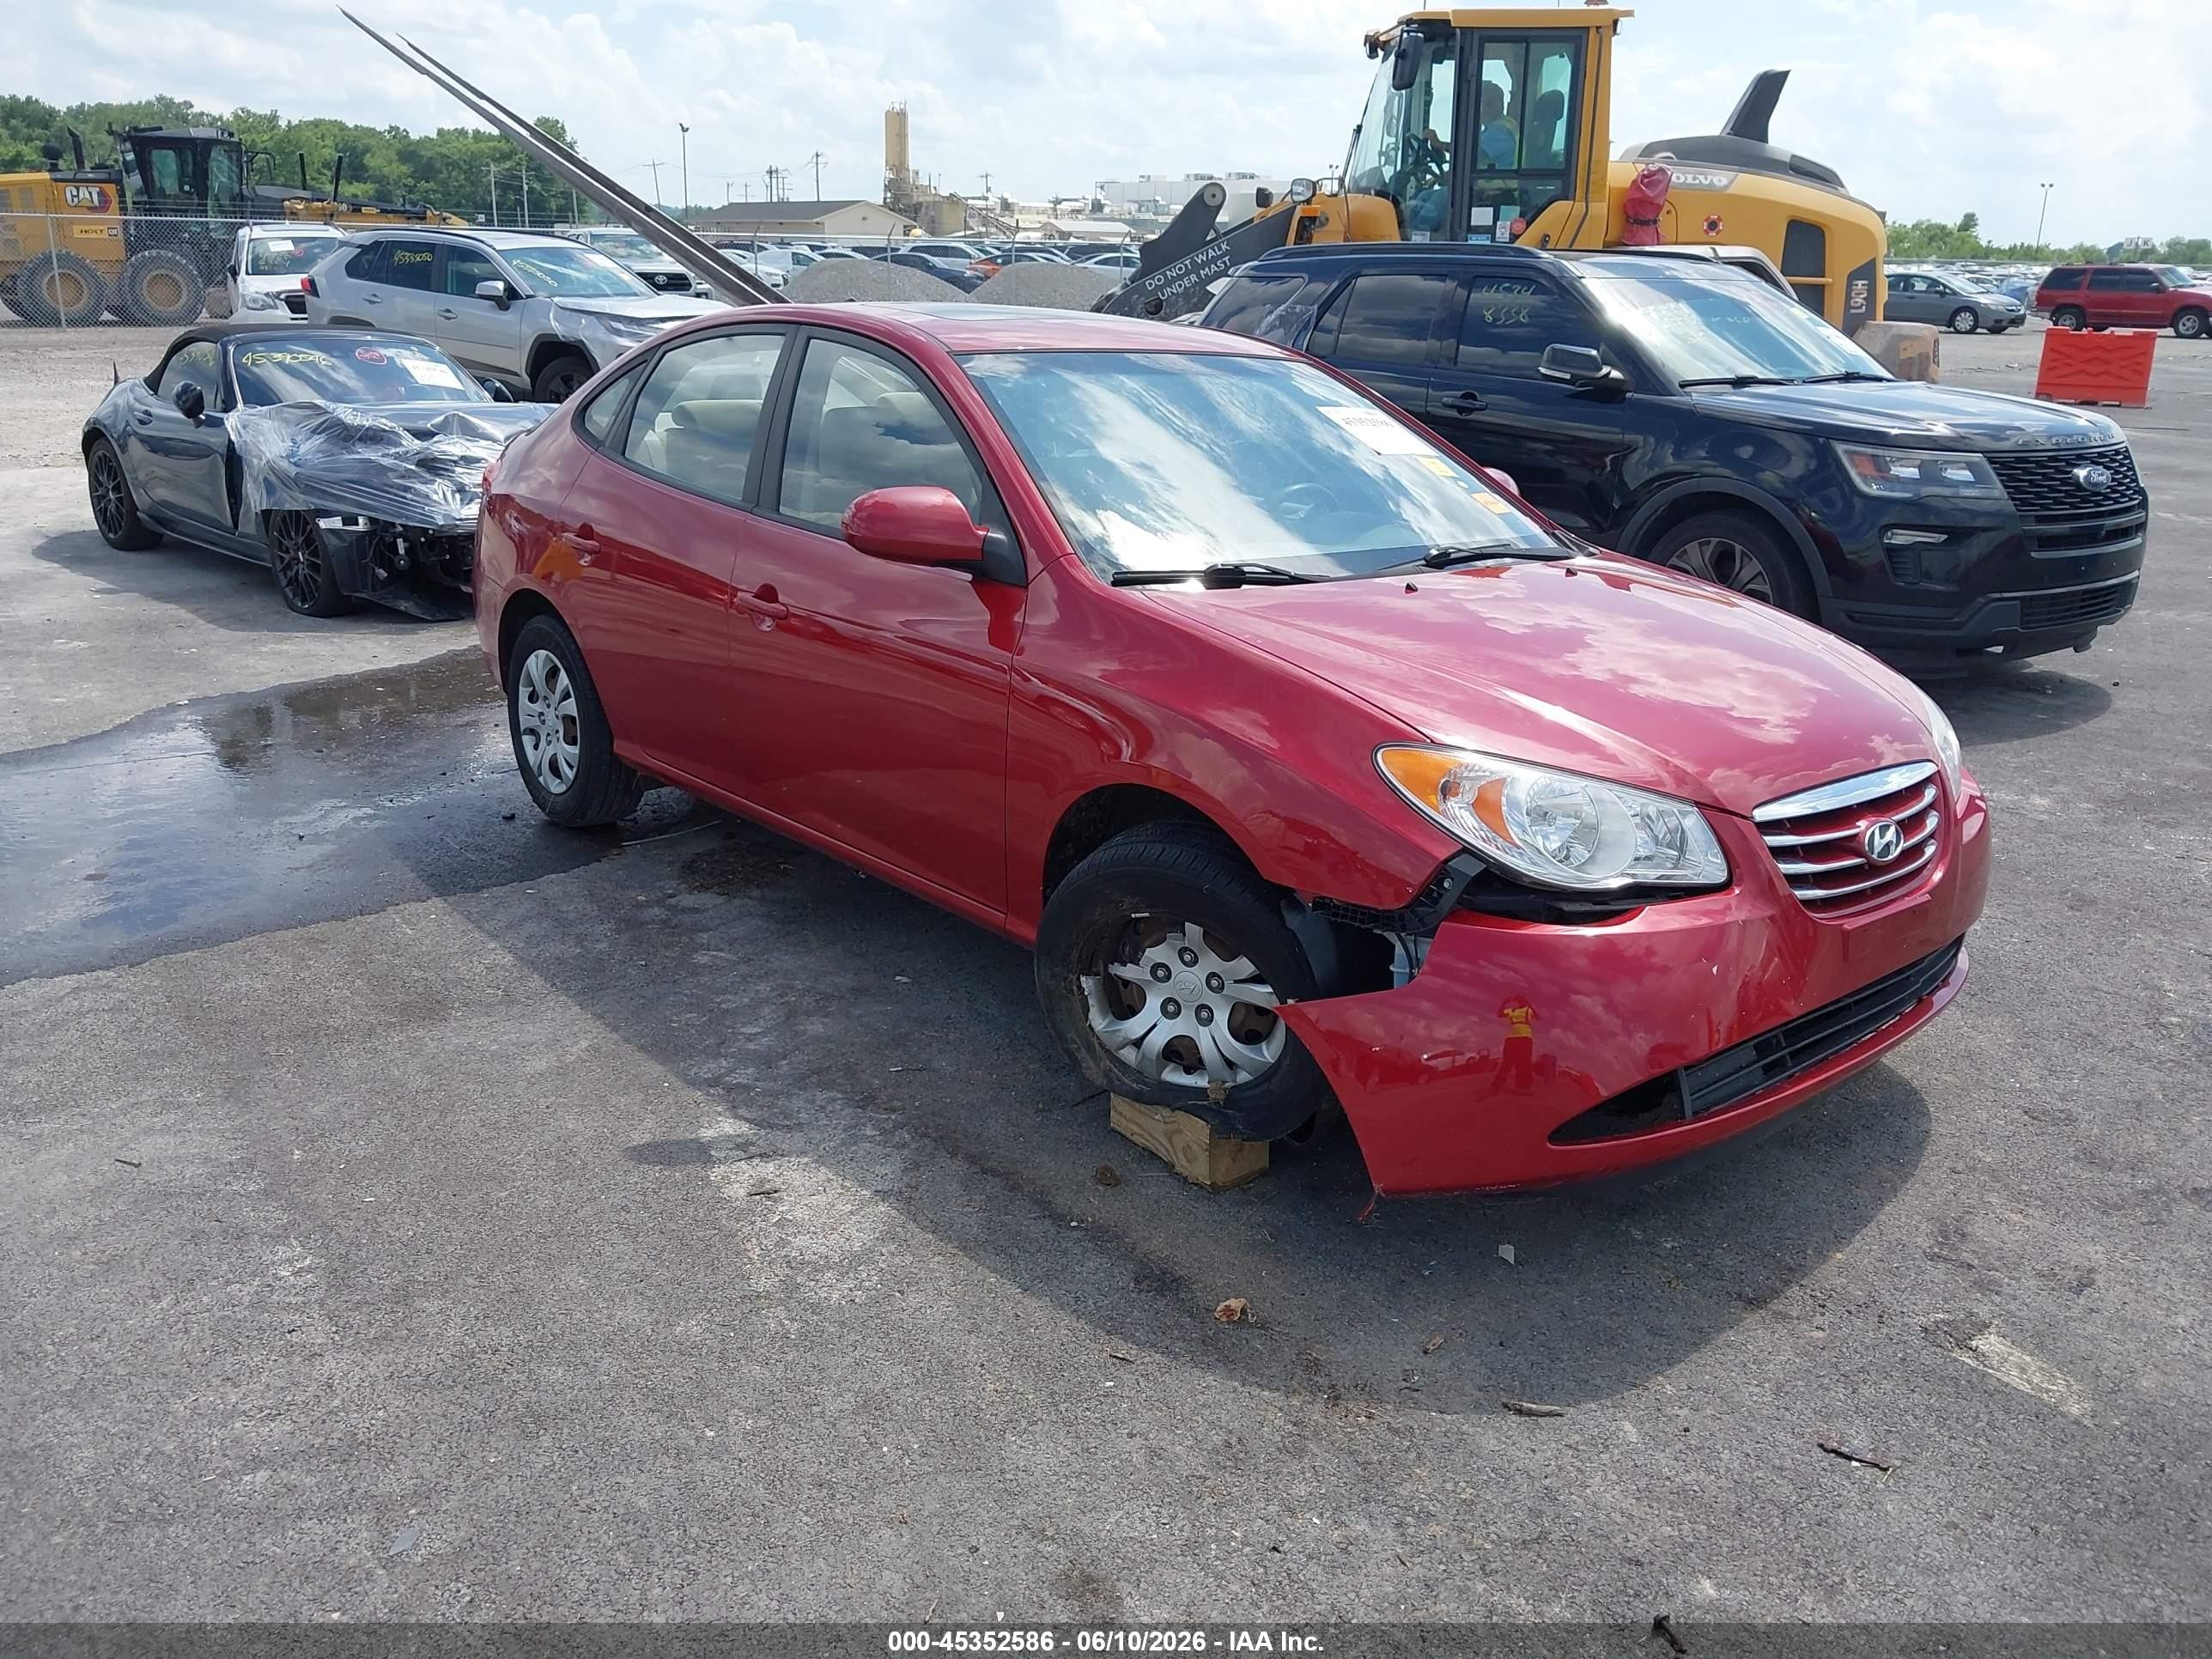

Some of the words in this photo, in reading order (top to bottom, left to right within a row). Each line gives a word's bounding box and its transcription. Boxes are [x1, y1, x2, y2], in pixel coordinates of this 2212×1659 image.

[1671, 173, 1728, 186] OLVO
[65, 185, 100, 207] CAT
[1145, 275, 1165, 291] DO
[1165, 258, 1192, 281] NOT
[1194, 240, 1231, 265] WALK
[1157, 273, 1200, 301] UNDER
[1199, 255, 1231, 280] MAST
[1850, 280, 1869, 313] L90H
[2017, 433, 2115, 446] EXPLORER
[2090, 470, 2107, 483] Ford
